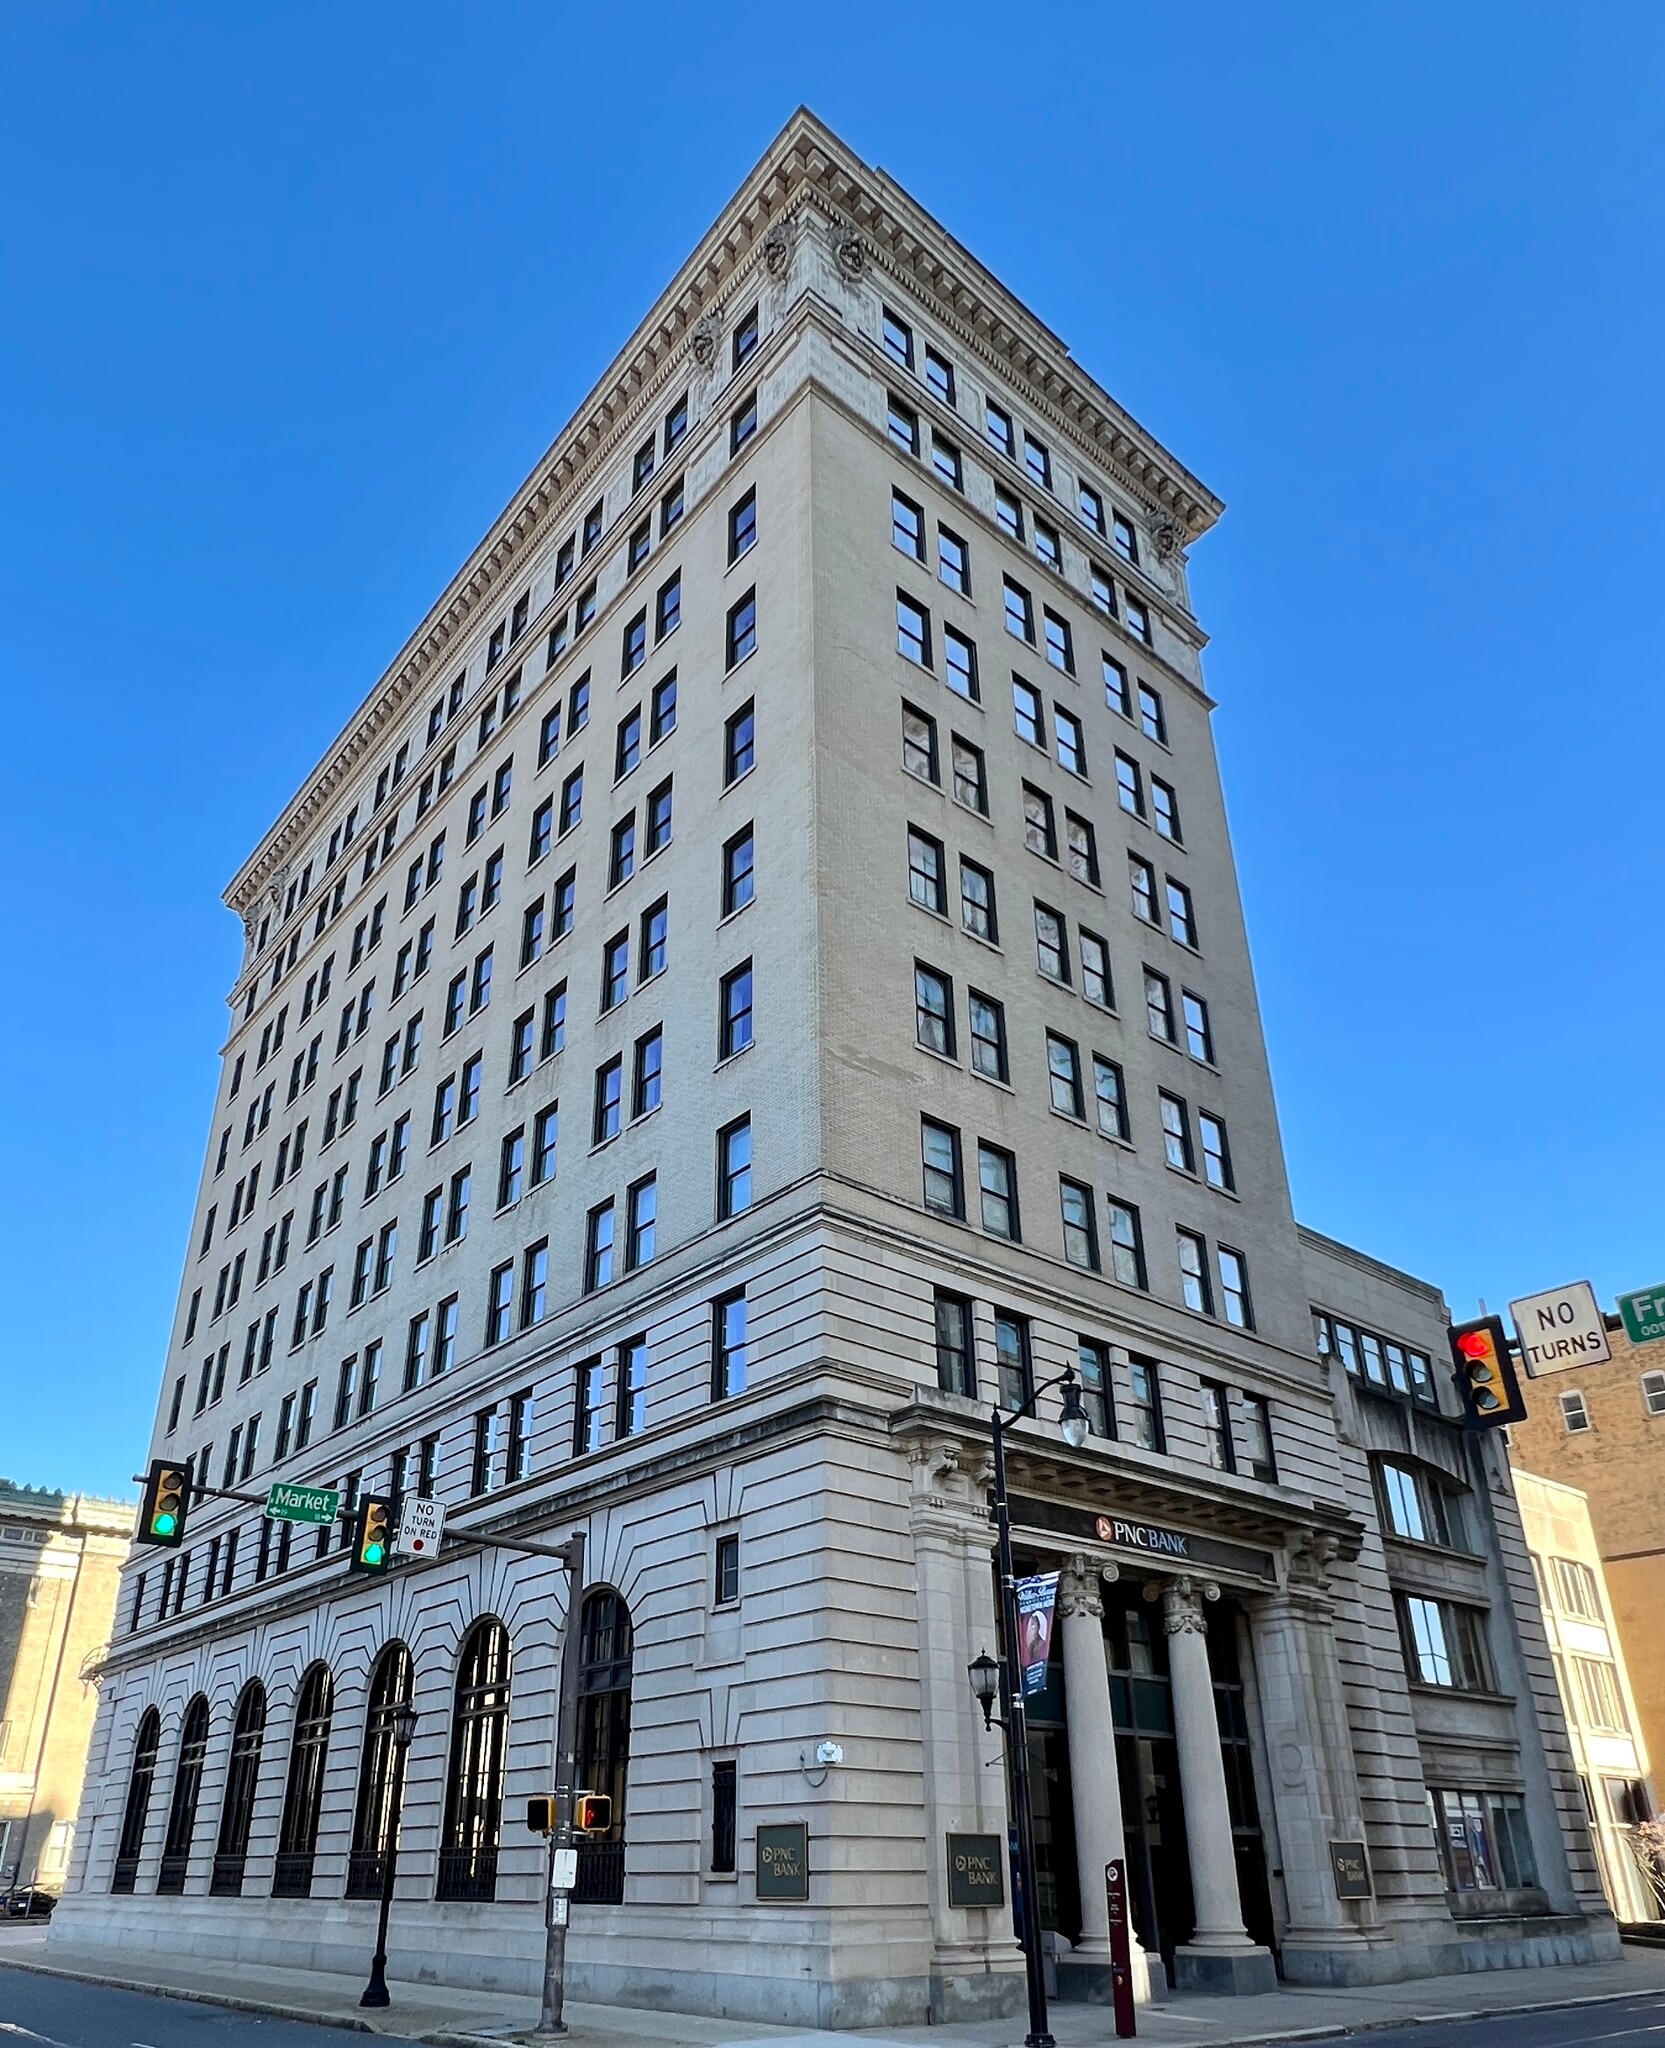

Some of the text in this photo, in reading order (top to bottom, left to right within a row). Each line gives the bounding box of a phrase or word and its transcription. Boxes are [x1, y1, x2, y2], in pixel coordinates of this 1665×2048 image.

[1537, 1302, 1574, 1331] NO
[1528, 1332, 1601, 1363] TURNS
[275, 1487, 330, 1511] Market
[416, 1503, 434, 1516] NO
[412, 1515, 436, 1528] TURN
[404, 1525, 438, 1540] ON RED
[773, 1847, 795, 1861] PNC
[773, 1861, 801, 1876] BANK
[967, 1856, 991, 1870] PNC
[968, 1871, 999, 1885] BANK
